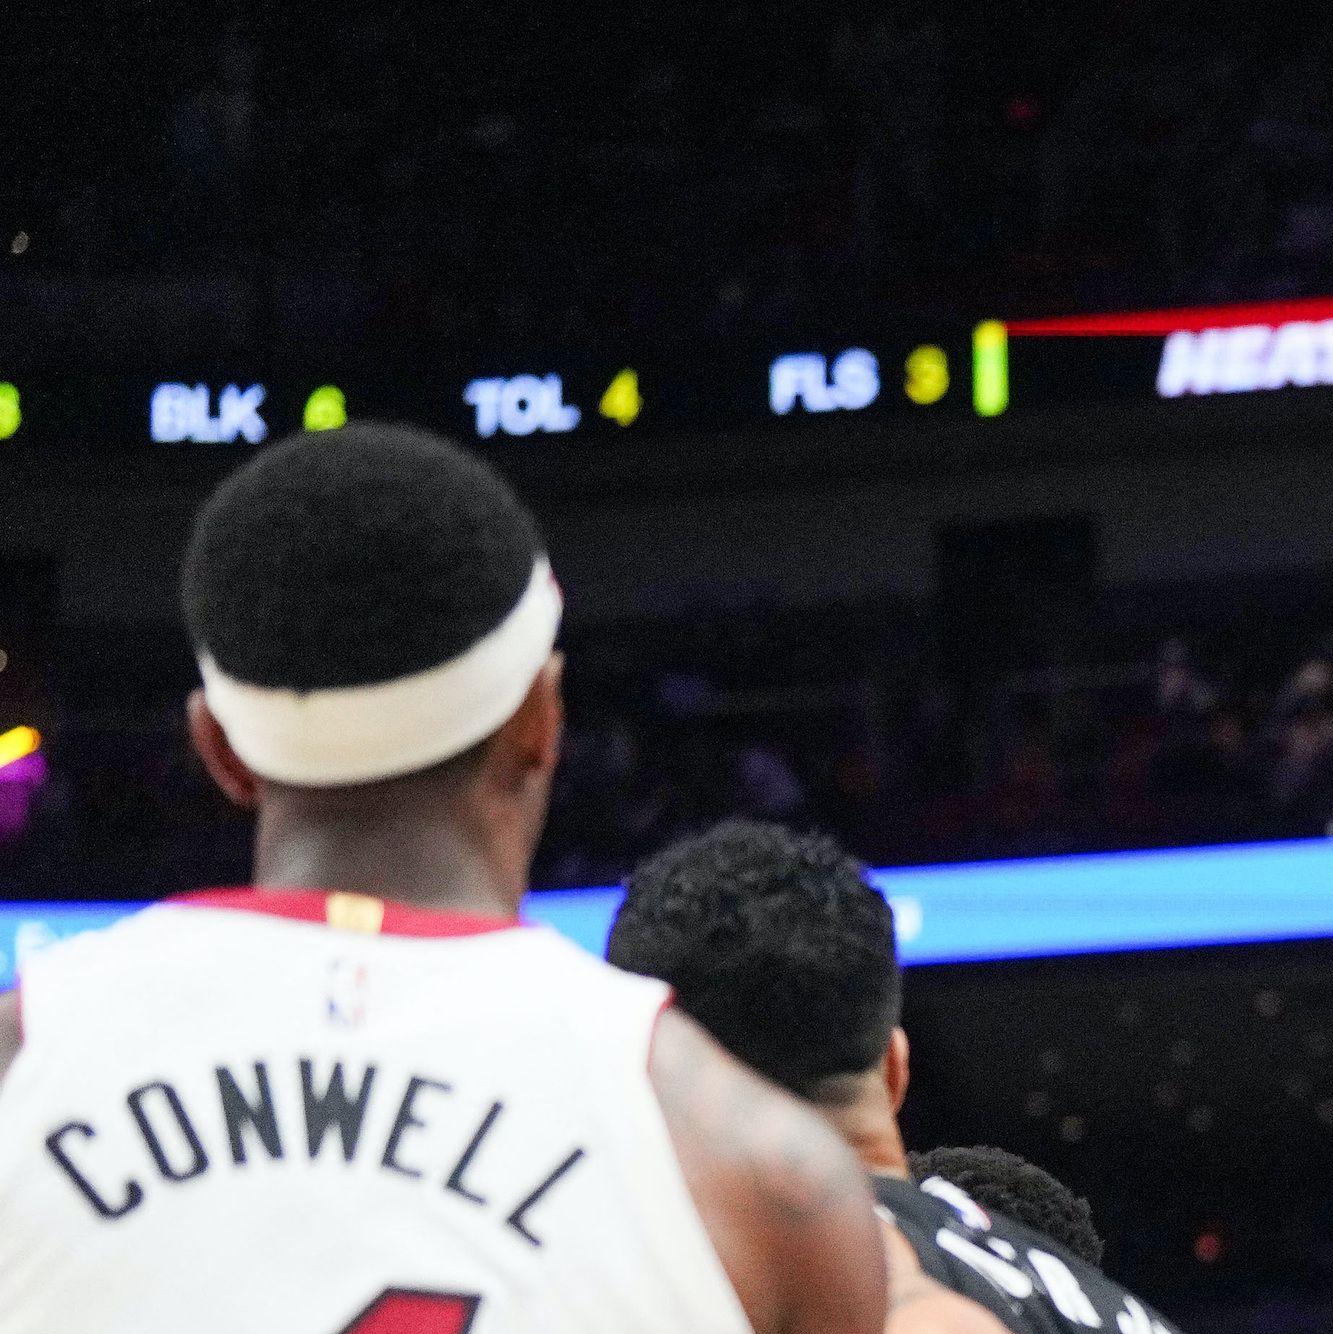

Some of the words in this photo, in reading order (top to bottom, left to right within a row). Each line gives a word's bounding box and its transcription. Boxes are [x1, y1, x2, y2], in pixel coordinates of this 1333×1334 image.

[149, 382, 267, 443] BLK
[463, 373, 581, 437] TOL
[768, 348, 880, 415] FLS
[44, 1057, 586, 1247] CONWELL
